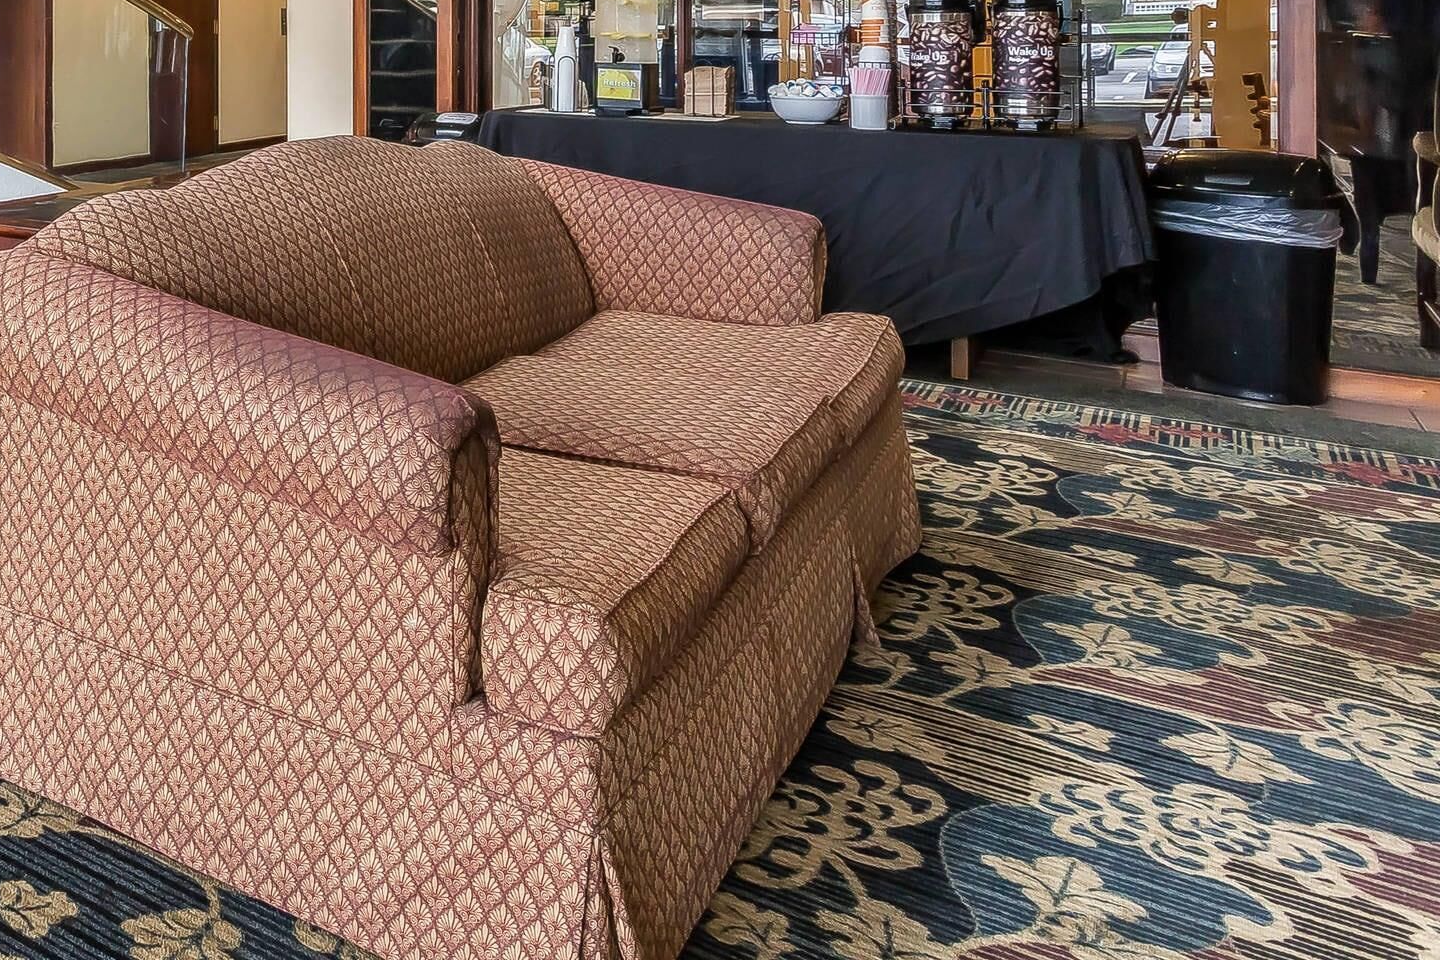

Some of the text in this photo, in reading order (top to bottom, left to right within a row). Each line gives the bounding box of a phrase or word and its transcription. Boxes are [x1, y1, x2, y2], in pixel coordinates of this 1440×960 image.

[932, 50, 948, 62] Up
[1008, 46, 1053, 57] Wake Up
[603, 79, 636, 88] Refresh
